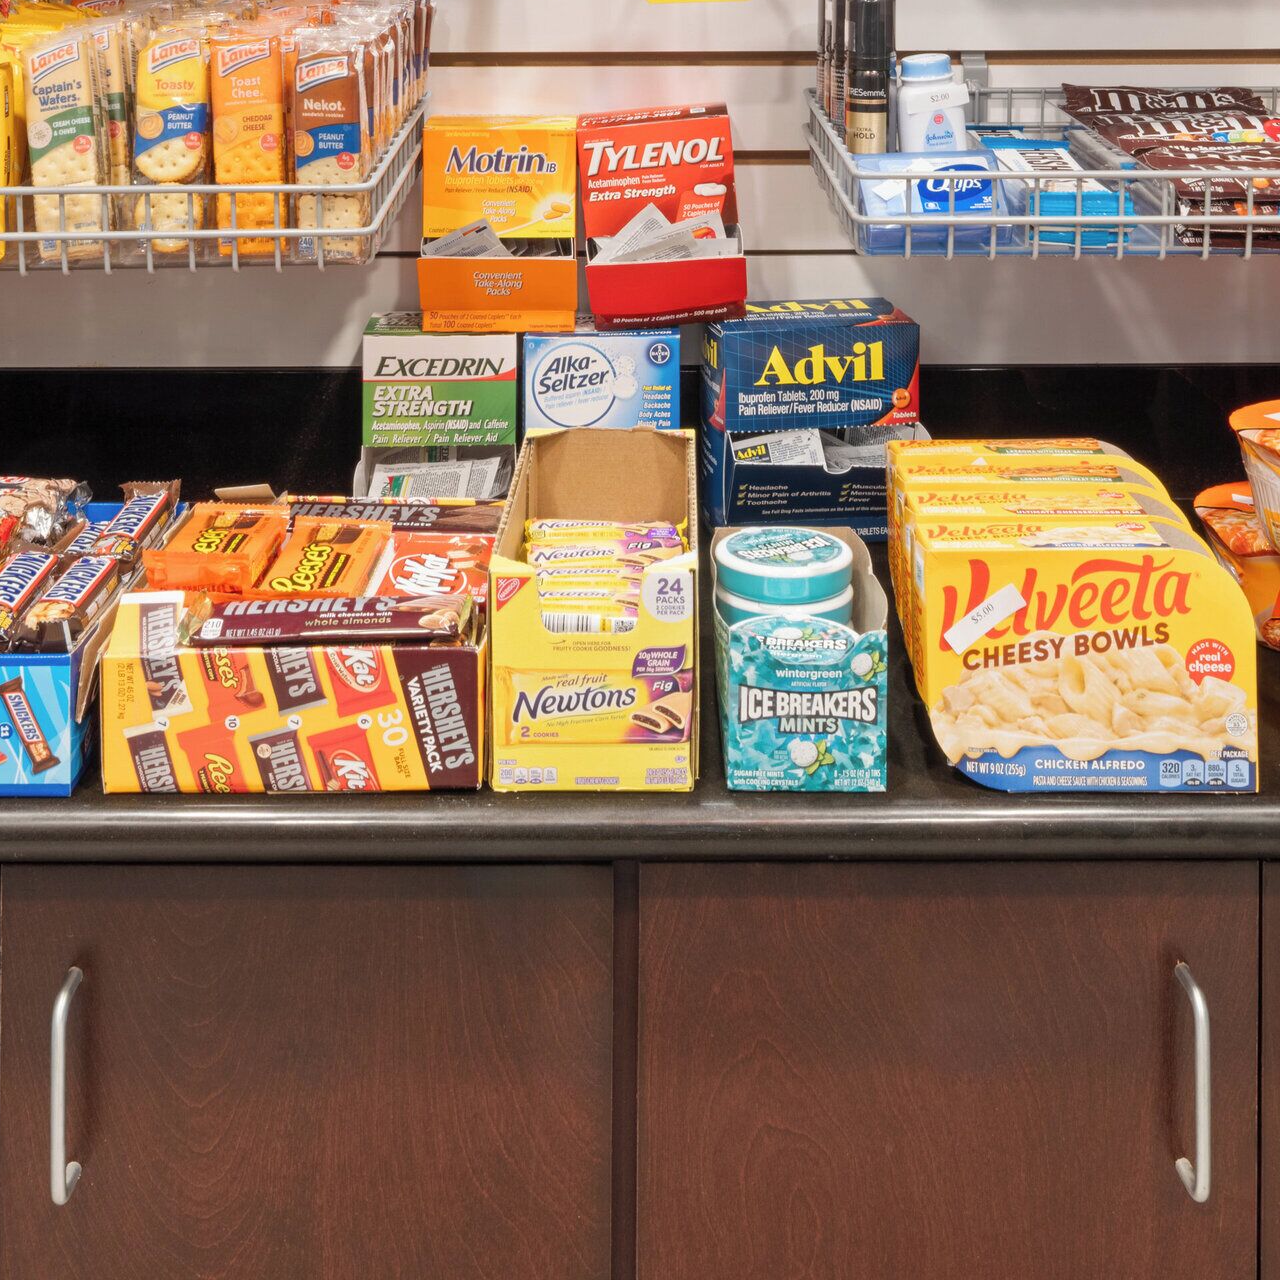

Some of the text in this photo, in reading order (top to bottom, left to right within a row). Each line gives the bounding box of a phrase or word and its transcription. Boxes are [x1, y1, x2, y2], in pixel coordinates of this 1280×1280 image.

[31, 43, 76, 74] Lance
[152, 40, 198, 64] Lance
[221, 42, 266, 67] Lance
[298, 61, 344, 83] Lance
[32, 79, 82, 97] Captain's
[155, 79, 194, 91] Toasty
[230, 77, 261, 87] Toast
[303, 98, 342, 111] Nekot
[930, 93, 950, 103] $2.00
[167, 122, 193, 130] BUTTER
[242, 114, 273, 123] CHEDDAR
[318, 133, 345, 141] PEANUT
[853, 132, 876, 140] HOLD
[318, 142, 344, 150] BUTTER
[445, 145, 546, 174] Motrin
[584, 136, 725, 177] TYLENOL
[588, 176, 641, 190] Acetaminophen
[589, 184, 677, 203] Extra Strength
[473, 271, 522, 280] Convenient
[474, 279, 523, 289] Take-Along
[486, 287, 511, 296] Packs
[374, 356, 505, 377] EXCEDRIN
[543, 355, 598, 377] Alka-
[753, 340, 885, 386] Advil
[538, 370, 609, 395] Seltzer
[373, 385, 433, 401] EXTRA
[738, 390, 839, 406] Ibuprofen Tablets, 200 mg
[372, 400, 473, 417] STRENGTH
[643, 401, 671, 409] Backache
[738, 405, 756, 416] Pain
[817, 400, 849, 412] Reducer
[851, 397, 882, 412] (NSAID)
[892, 411, 916, 419] Tablets
[736, 445, 767, 460] Advil
[746, 498, 788, 506] Toothache
[534, 548, 615, 562] Newtons
[656, 577, 684, 596] 24
[655, 596, 686, 604] PACKS
[305, 616, 392, 626] whole almonds
[971, 603, 995, 624] $5.00
[147, 606, 182, 690] HERSHEY'S
[766, 637, 848, 651] BREAKERS
[962, 622, 1171, 671] CHEESY BOWLS
[647, 659, 670, 667] GRAIN
[1199, 652, 1221, 662] real
[776, 668, 843, 679] wintergreen
[1188, 660, 1233, 674] cheese
[556, 674, 609, 689] real fruit
[652, 681, 674, 692] Fig
[512, 685, 637, 723] Newtons
[740, 686, 878, 721] ICE BREAKERS
[8, 693, 40, 742] SNICKERS
[420, 662, 475, 771] HERSHEY'S
[377, 709, 410, 748] 30
[407, 675, 444, 774] VARIETY PACK
[520, 726, 531, 738] 2
[779, 717, 838, 733] MINTS
[1034, 758, 1146, 771] CHICKEN ALFREDO
[1162, 762, 1180, 774] 320
